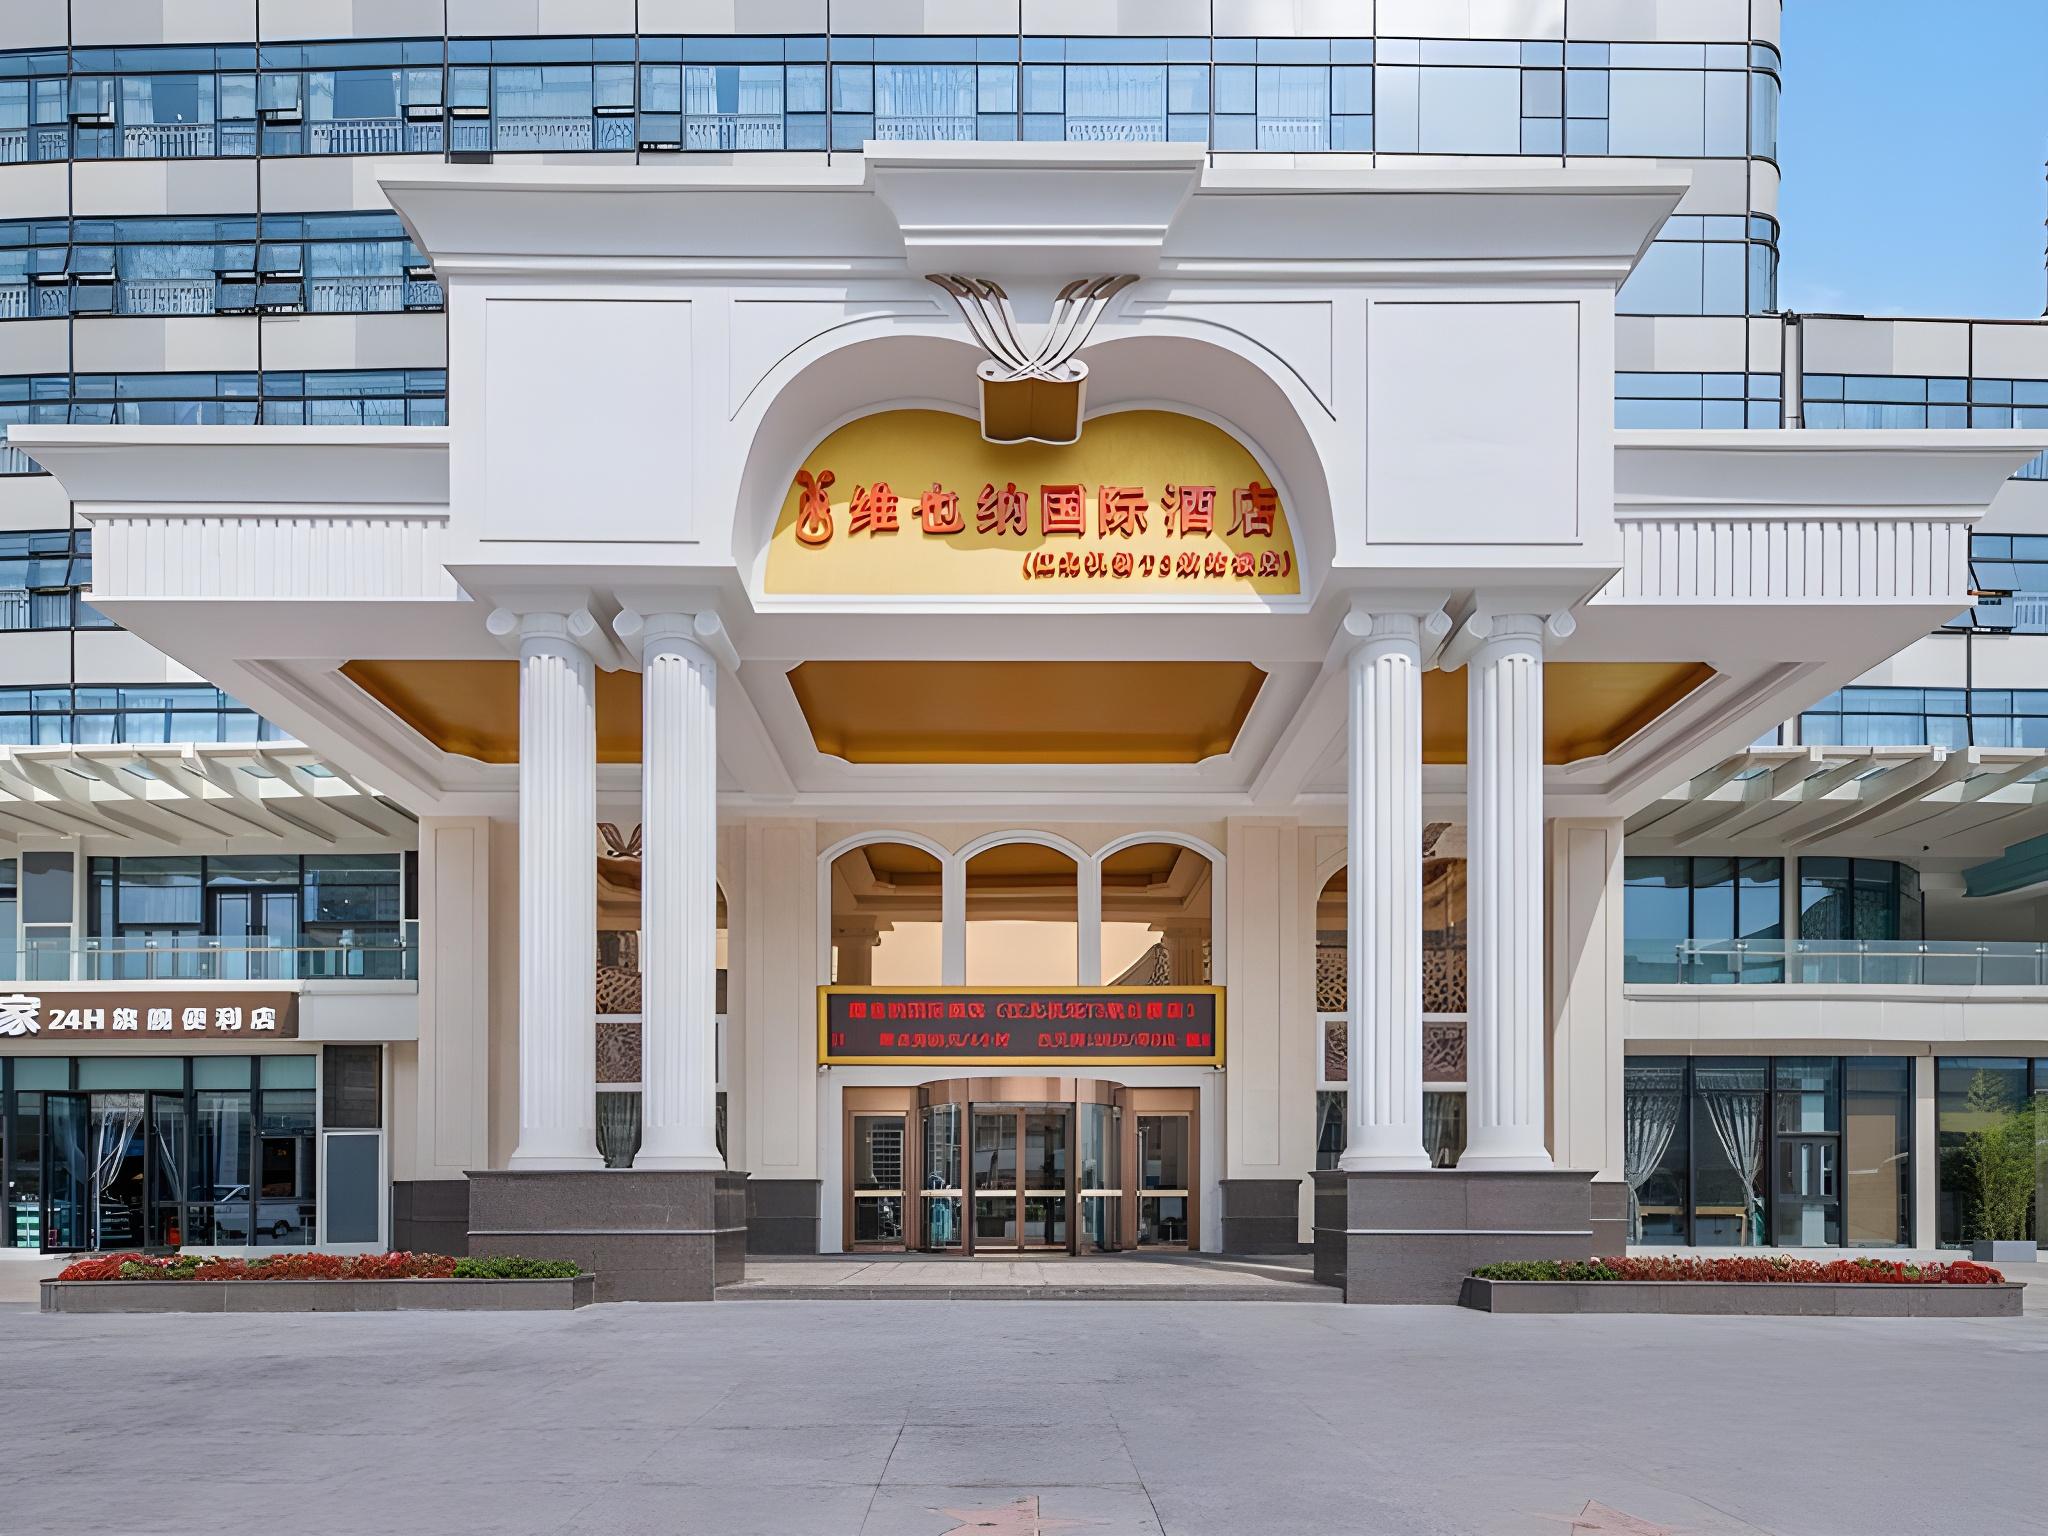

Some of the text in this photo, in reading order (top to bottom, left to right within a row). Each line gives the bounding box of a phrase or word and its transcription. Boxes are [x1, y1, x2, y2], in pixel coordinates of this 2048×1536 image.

[848, 481, 1278, 538] 维也纳国际酒店
